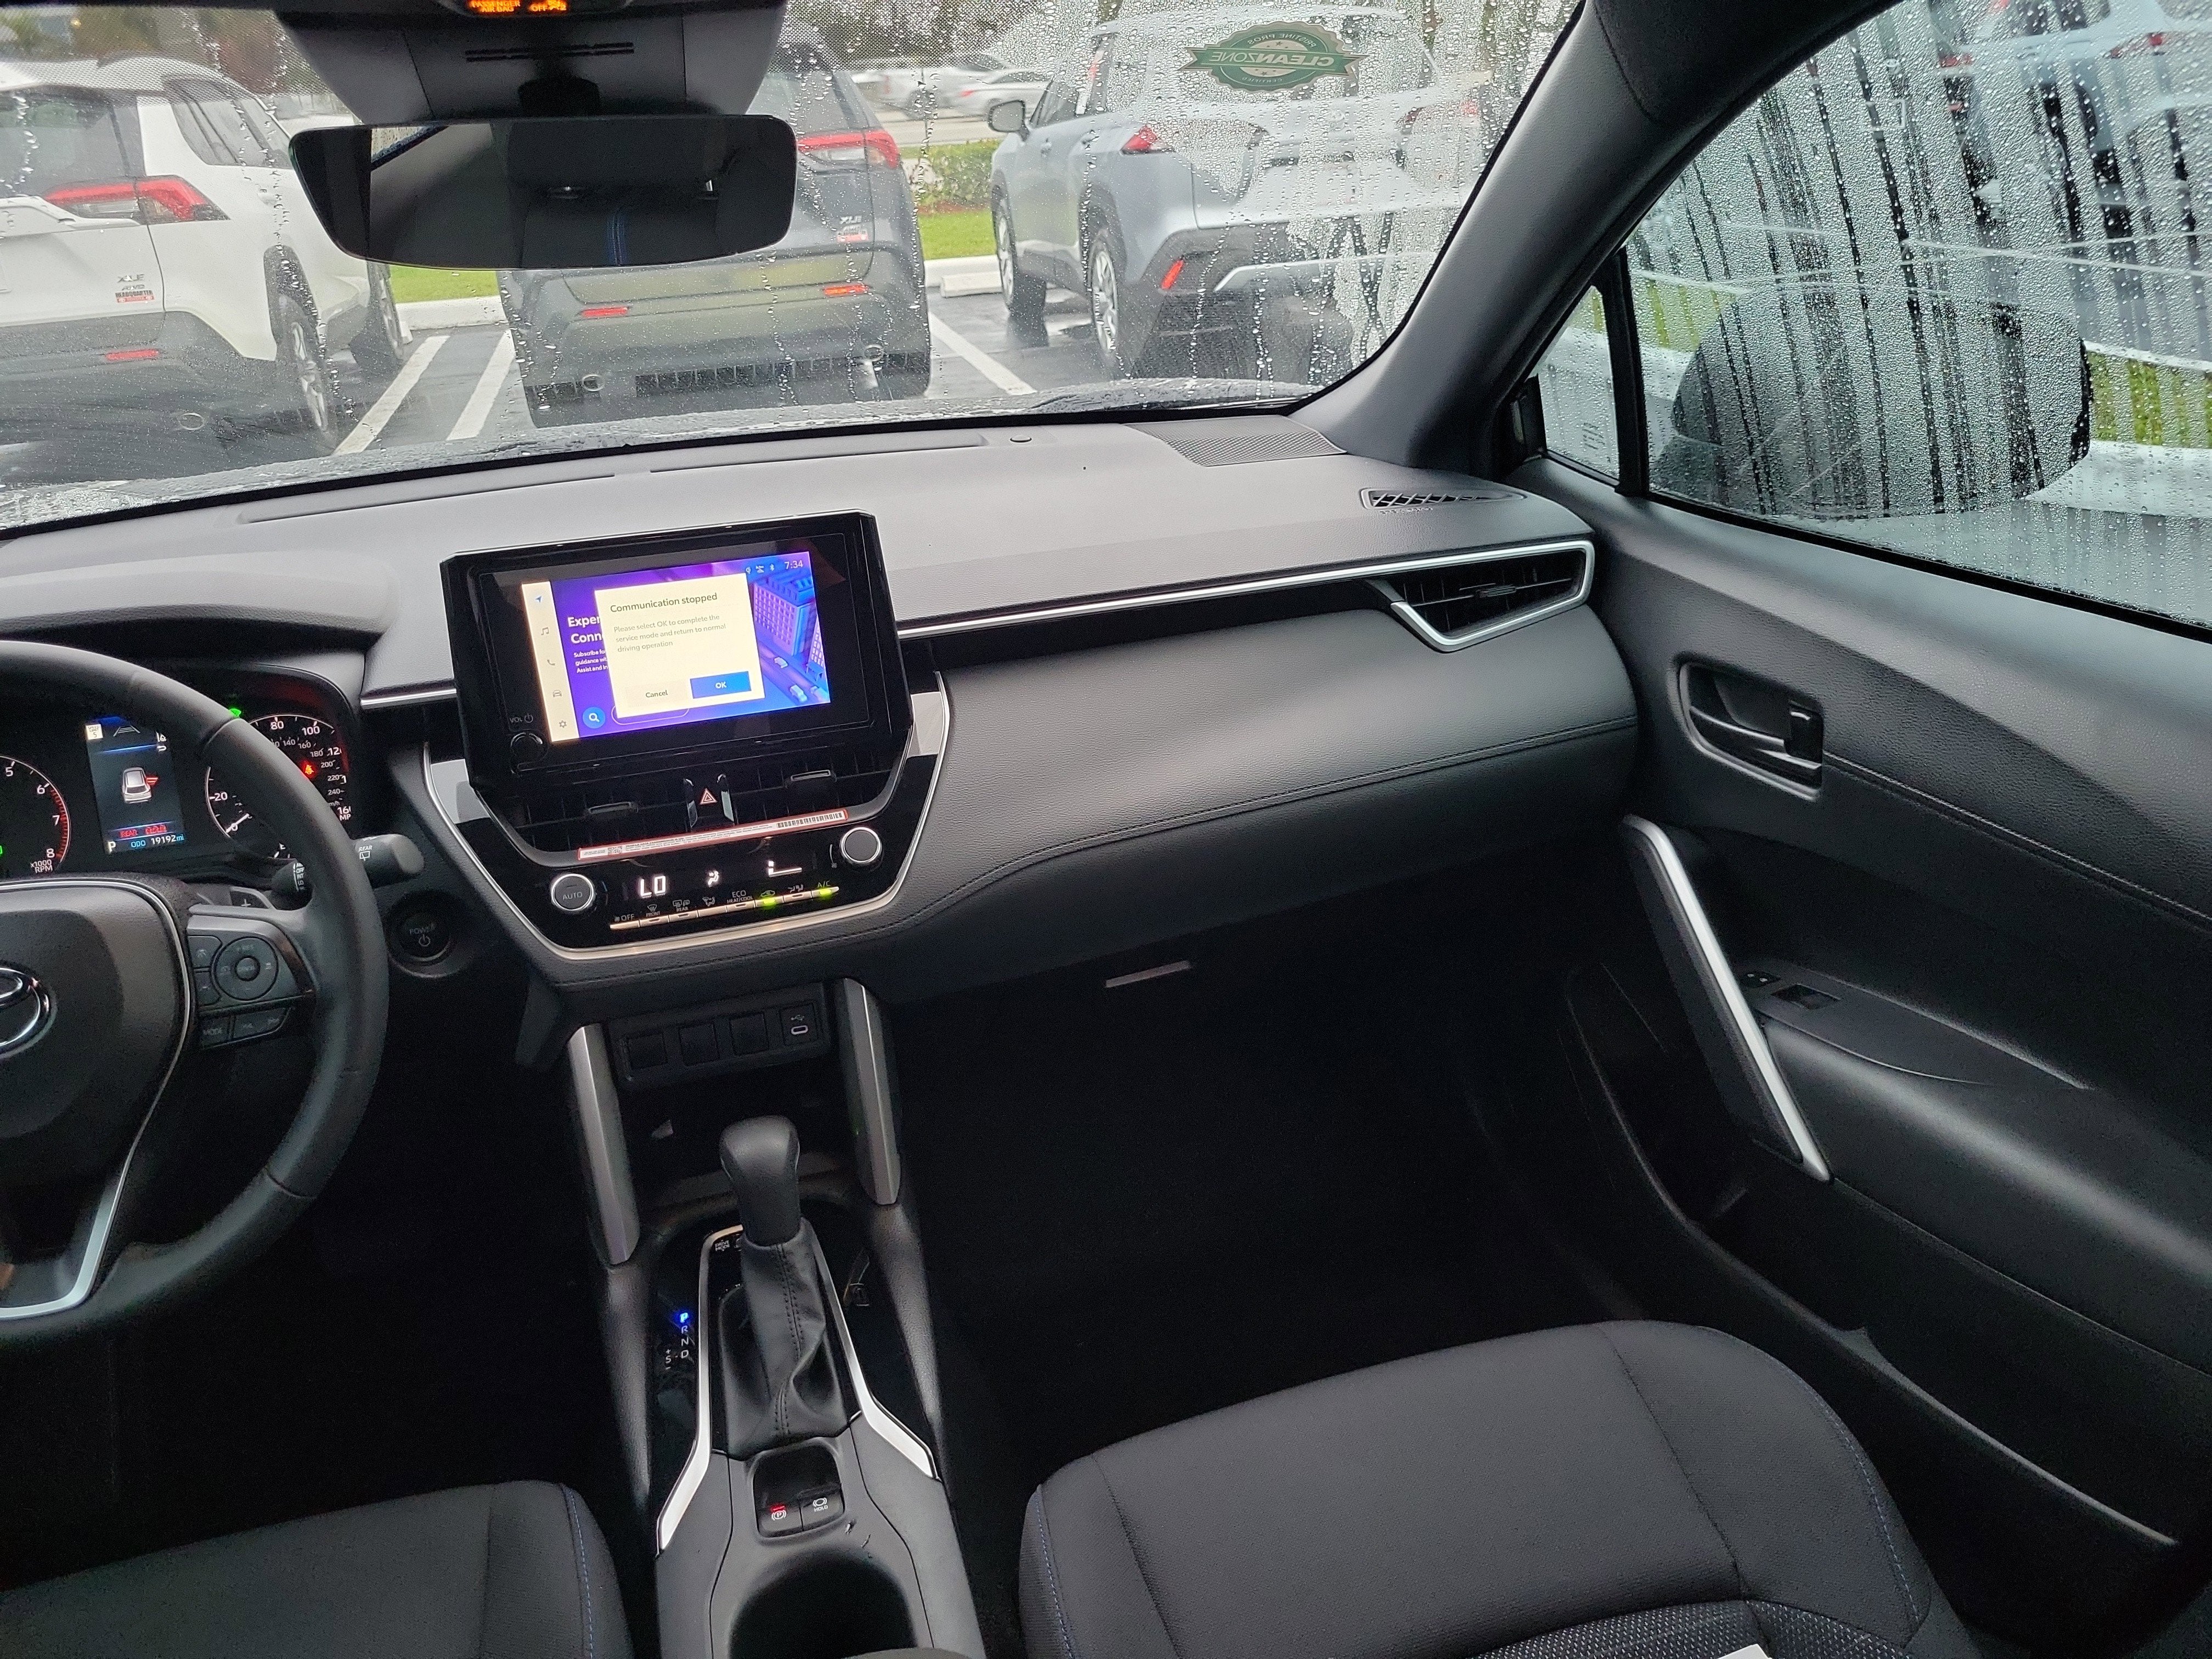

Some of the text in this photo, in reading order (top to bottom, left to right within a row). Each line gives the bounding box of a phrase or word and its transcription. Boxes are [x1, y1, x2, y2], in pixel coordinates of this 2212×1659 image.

[784, 560, 803, 570] 7:34
[610, 592, 718, 612] Communication stopped
[677, 616, 708, 625] complete
[617, 640, 673, 652] driving operation
[573, 650, 599, 658] Subscribe
[575, 658, 599, 667] guidance
[646, 690, 668, 698] Cancel
[270, 721, 284, 730] 80
[302, 726, 320, 736] 100
[5, 768, 13, 776] 5
[37, 785, 45, 794] 6
[215, 792, 228, 801] 20
[52, 815, 60, 826] 7
[108, 840, 116, 852] P
[46, 848, 55, 857] 8
[31, 859, 52, 868] x1000
[35, 866, 53, 874] RPM
[640, 876, 667, 899] LO
[562, 891, 583, 900] AUTO
[732, 890, 747, 898] ECO
[680, 1312, 688, 1323] P
[681, 1325, 689, 1334] R
[681, 1337, 689, 1346] N
[681, 1350, 689, 1358] D
[665, 1355, 672, 1363] S
